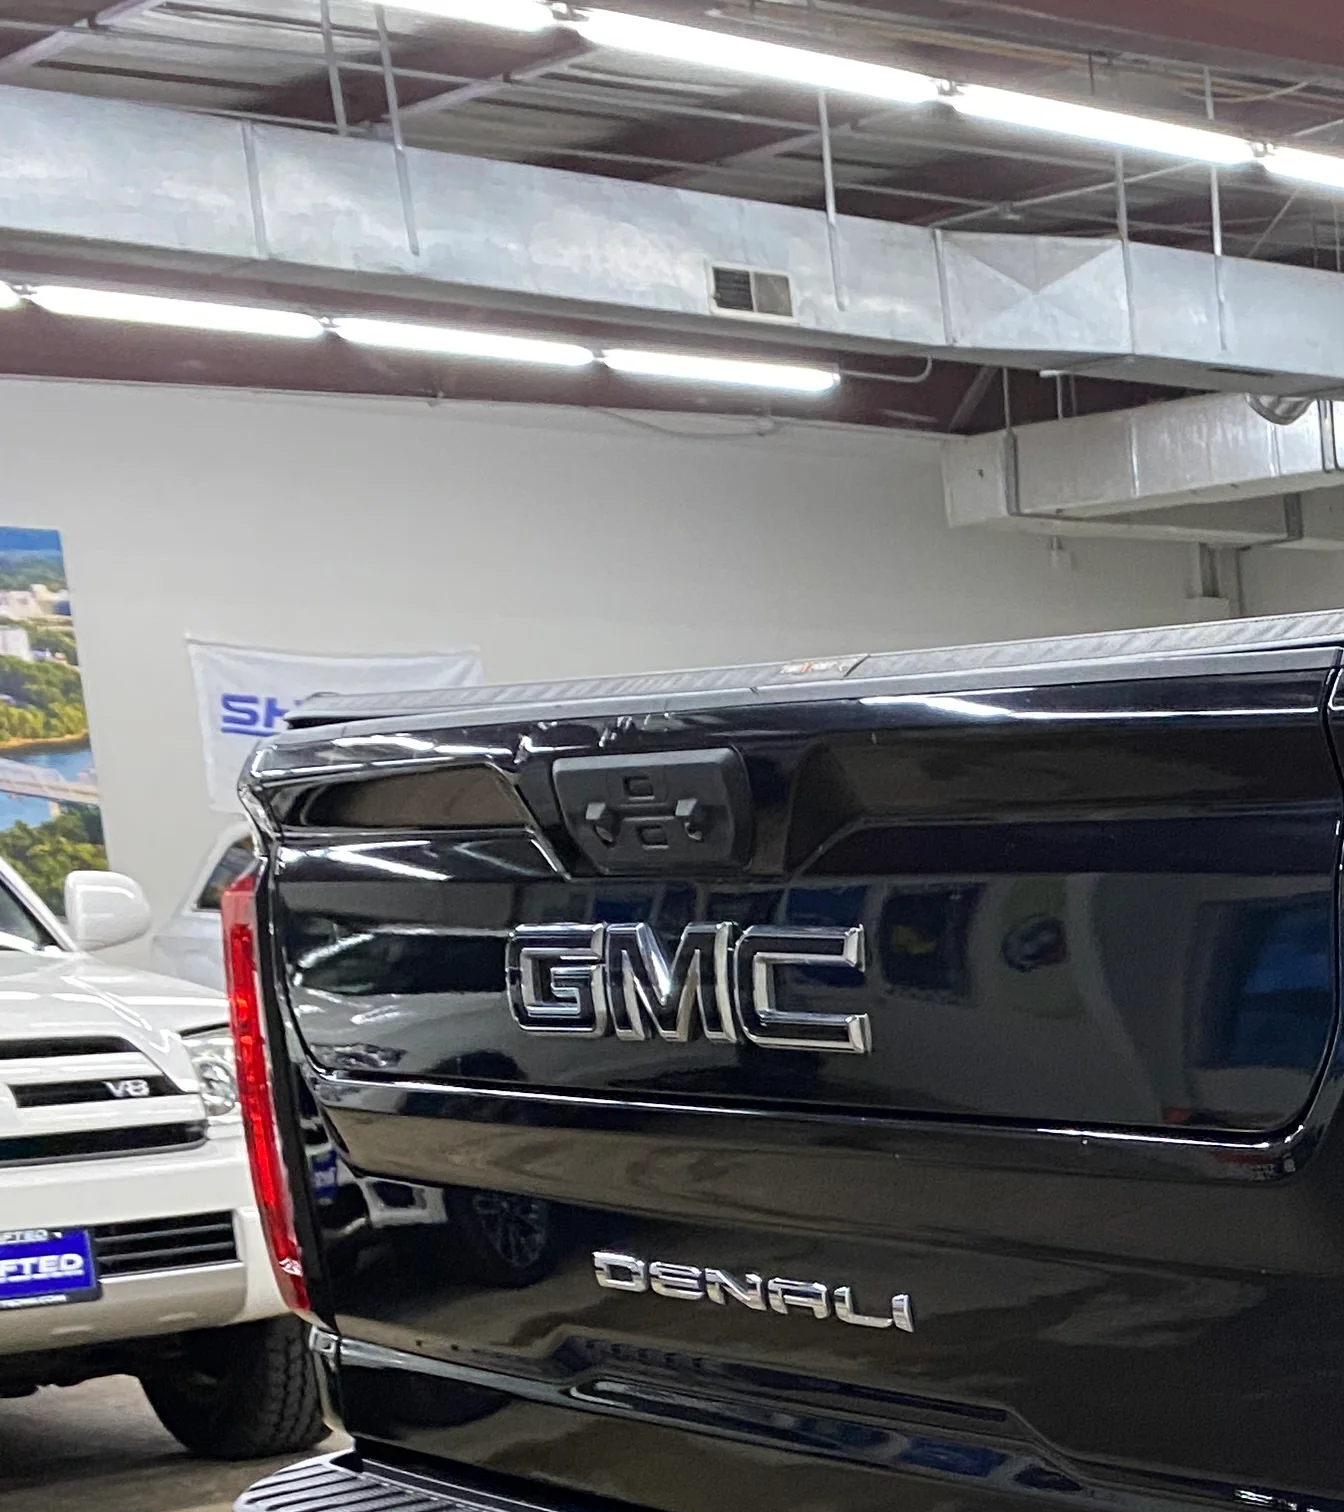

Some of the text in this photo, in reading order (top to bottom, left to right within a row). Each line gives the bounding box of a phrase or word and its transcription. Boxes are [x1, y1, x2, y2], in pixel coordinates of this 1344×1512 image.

[506, 921, 873, 1054] GMC
[103, 1080, 150, 1097] V8
[592, 1251, 914, 1332] DENALI
